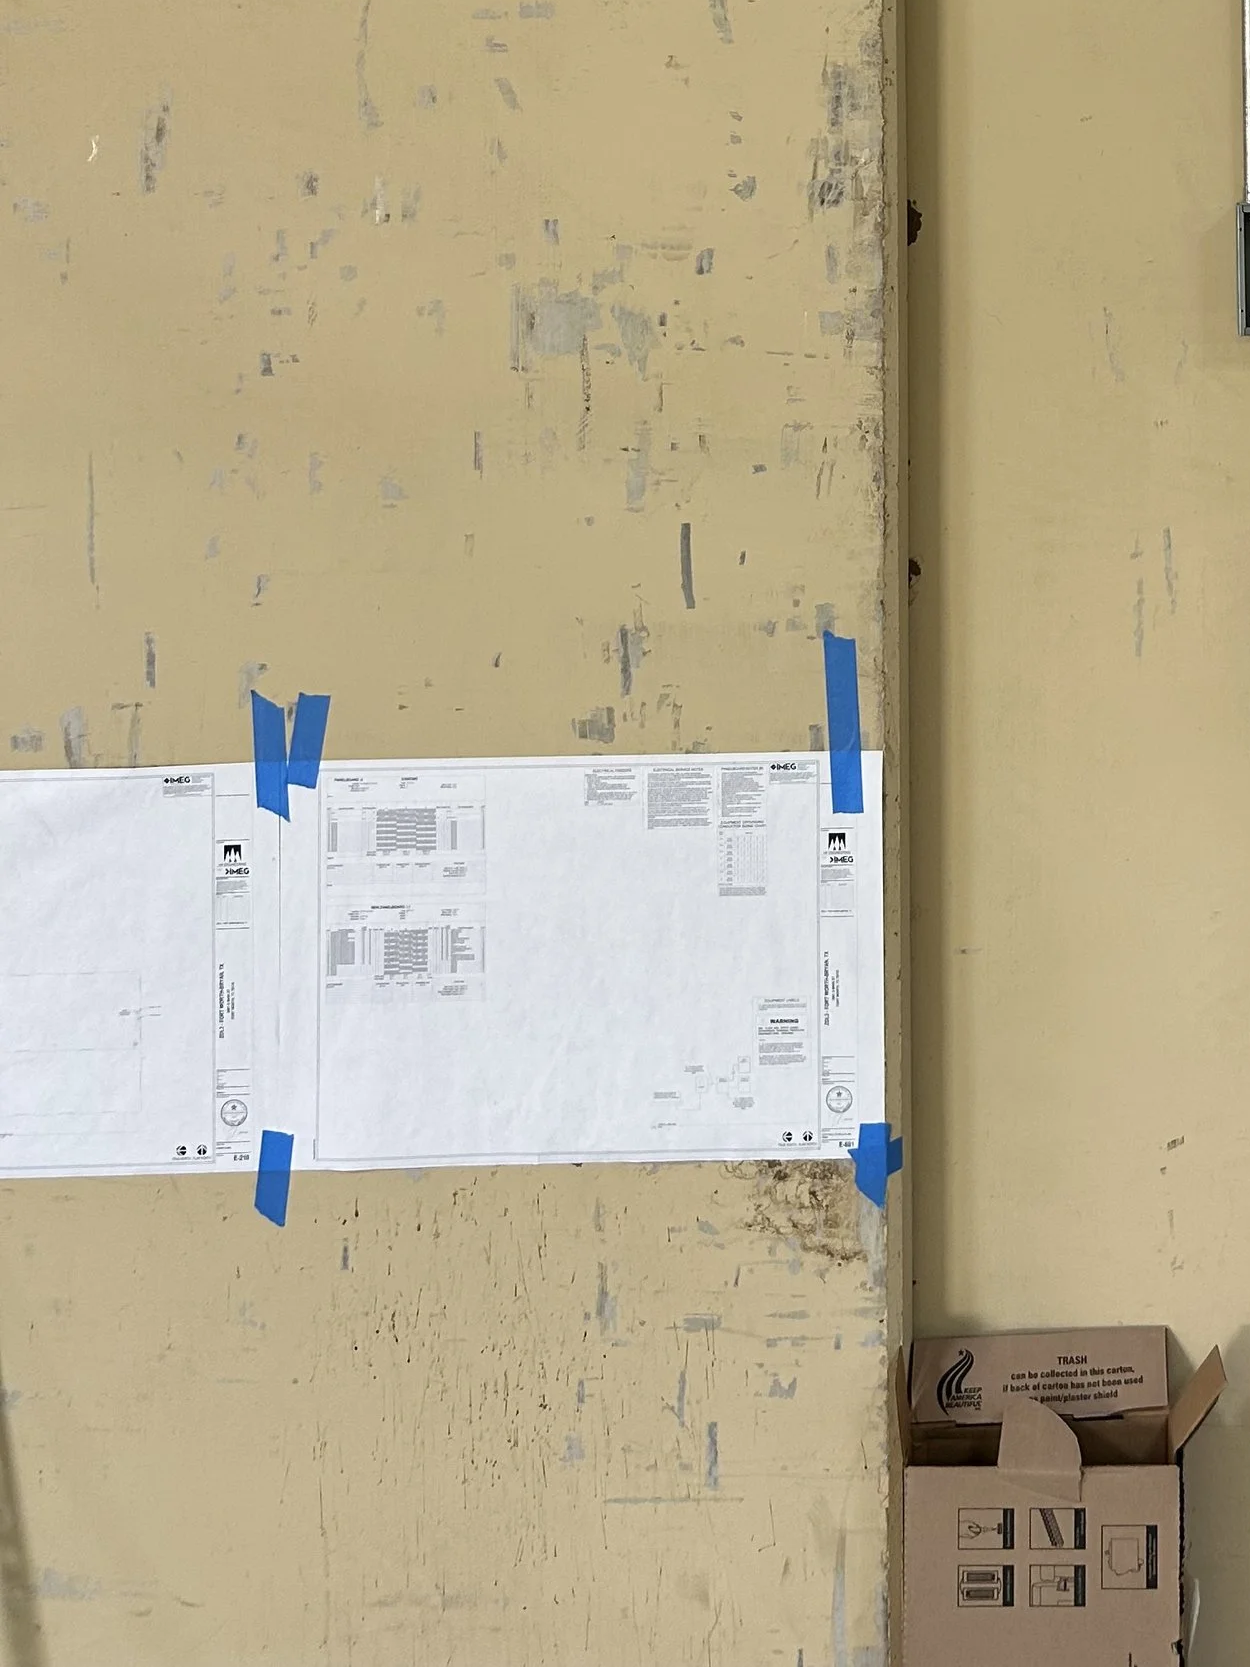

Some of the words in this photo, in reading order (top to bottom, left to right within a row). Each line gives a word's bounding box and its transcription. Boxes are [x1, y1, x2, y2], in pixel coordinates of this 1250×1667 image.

[1057, 1355, 1088, 1365] TRASH
[1011, 1372, 1026, 1380] can
[1028, 1370, 1039, 1379] be
[1040, 1368, 1078, 1379] collected
[1080, 1367, 1088, 1377] in
[1089, 1366, 1105, 1376] this
[1002, 1384, 1009, 1393] if
[1010, 1383, 1030, 1392] back
[1032, 1382, 1040, 1391] of
[1042, 1382, 1069, 1391] carton
[1070, 1381, 1085, 1389] has
[1087, 1379, 1100, 1388] not
[1102, 1378, 1122, 1387] been
[1123, 1374, 1144, 1385] used
[964, 1386, 983, 1394] KEEP
[950, 1393, 983, 1402] AMERICA
[1040, 1393, 1092, 1404] paint/plaster
[1093, 1389, 1119, 1400] shield
